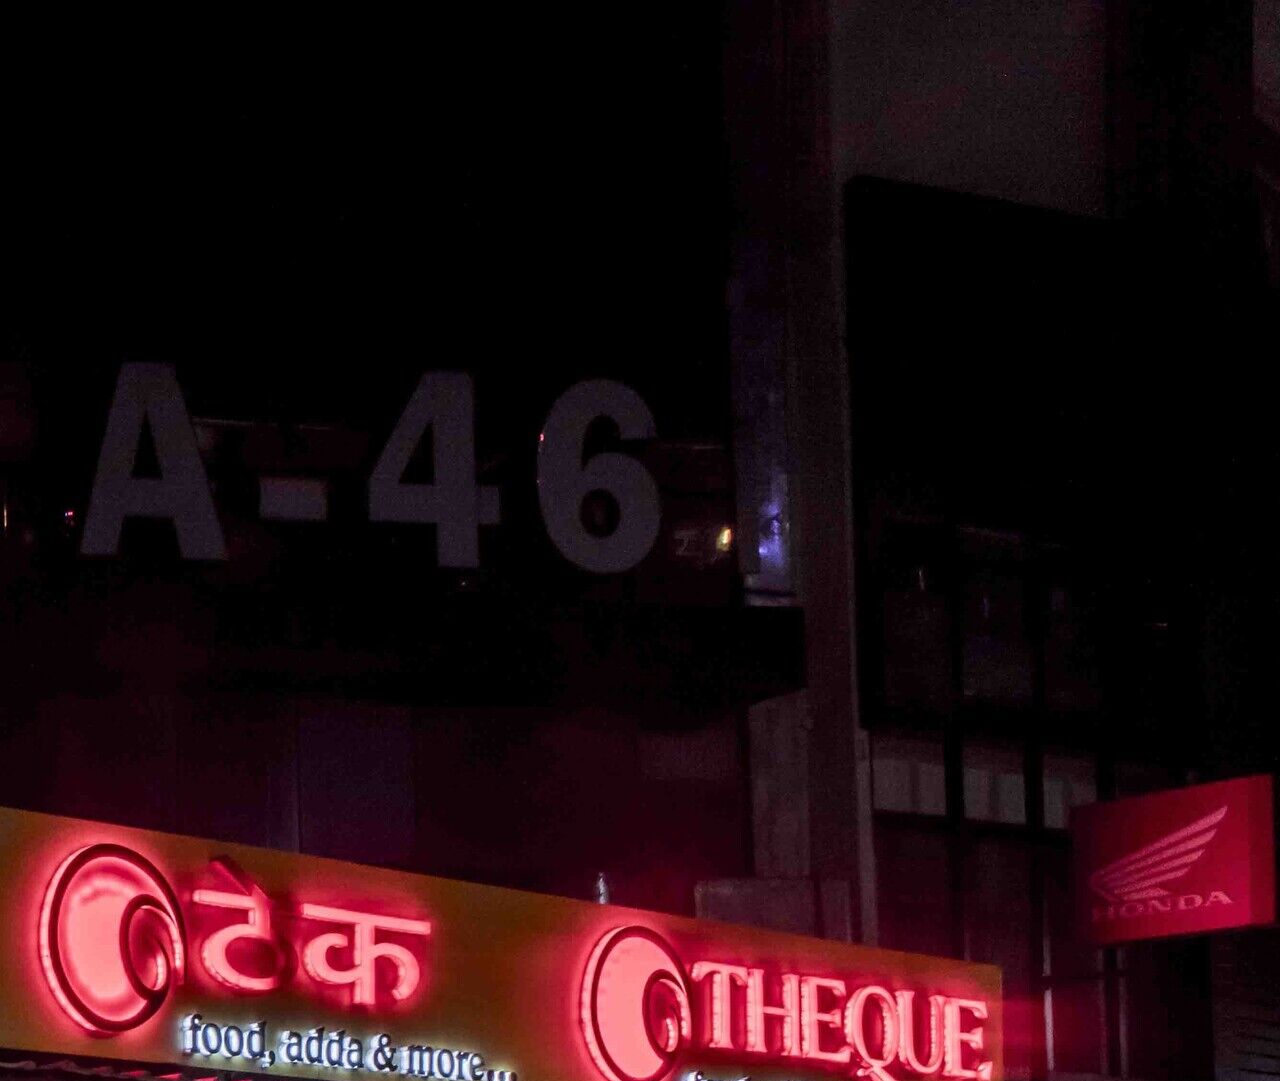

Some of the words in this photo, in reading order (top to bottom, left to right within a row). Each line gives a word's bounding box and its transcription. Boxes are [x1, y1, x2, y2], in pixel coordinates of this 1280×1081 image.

[79, 360, 662, 574] A-46
[1091, 890, 1234, 920] HONDA
[183, 1013, 276, 1068] food,
[282, 1027, 364, 1070] adda
[368, 1033, 398, 1072] &
